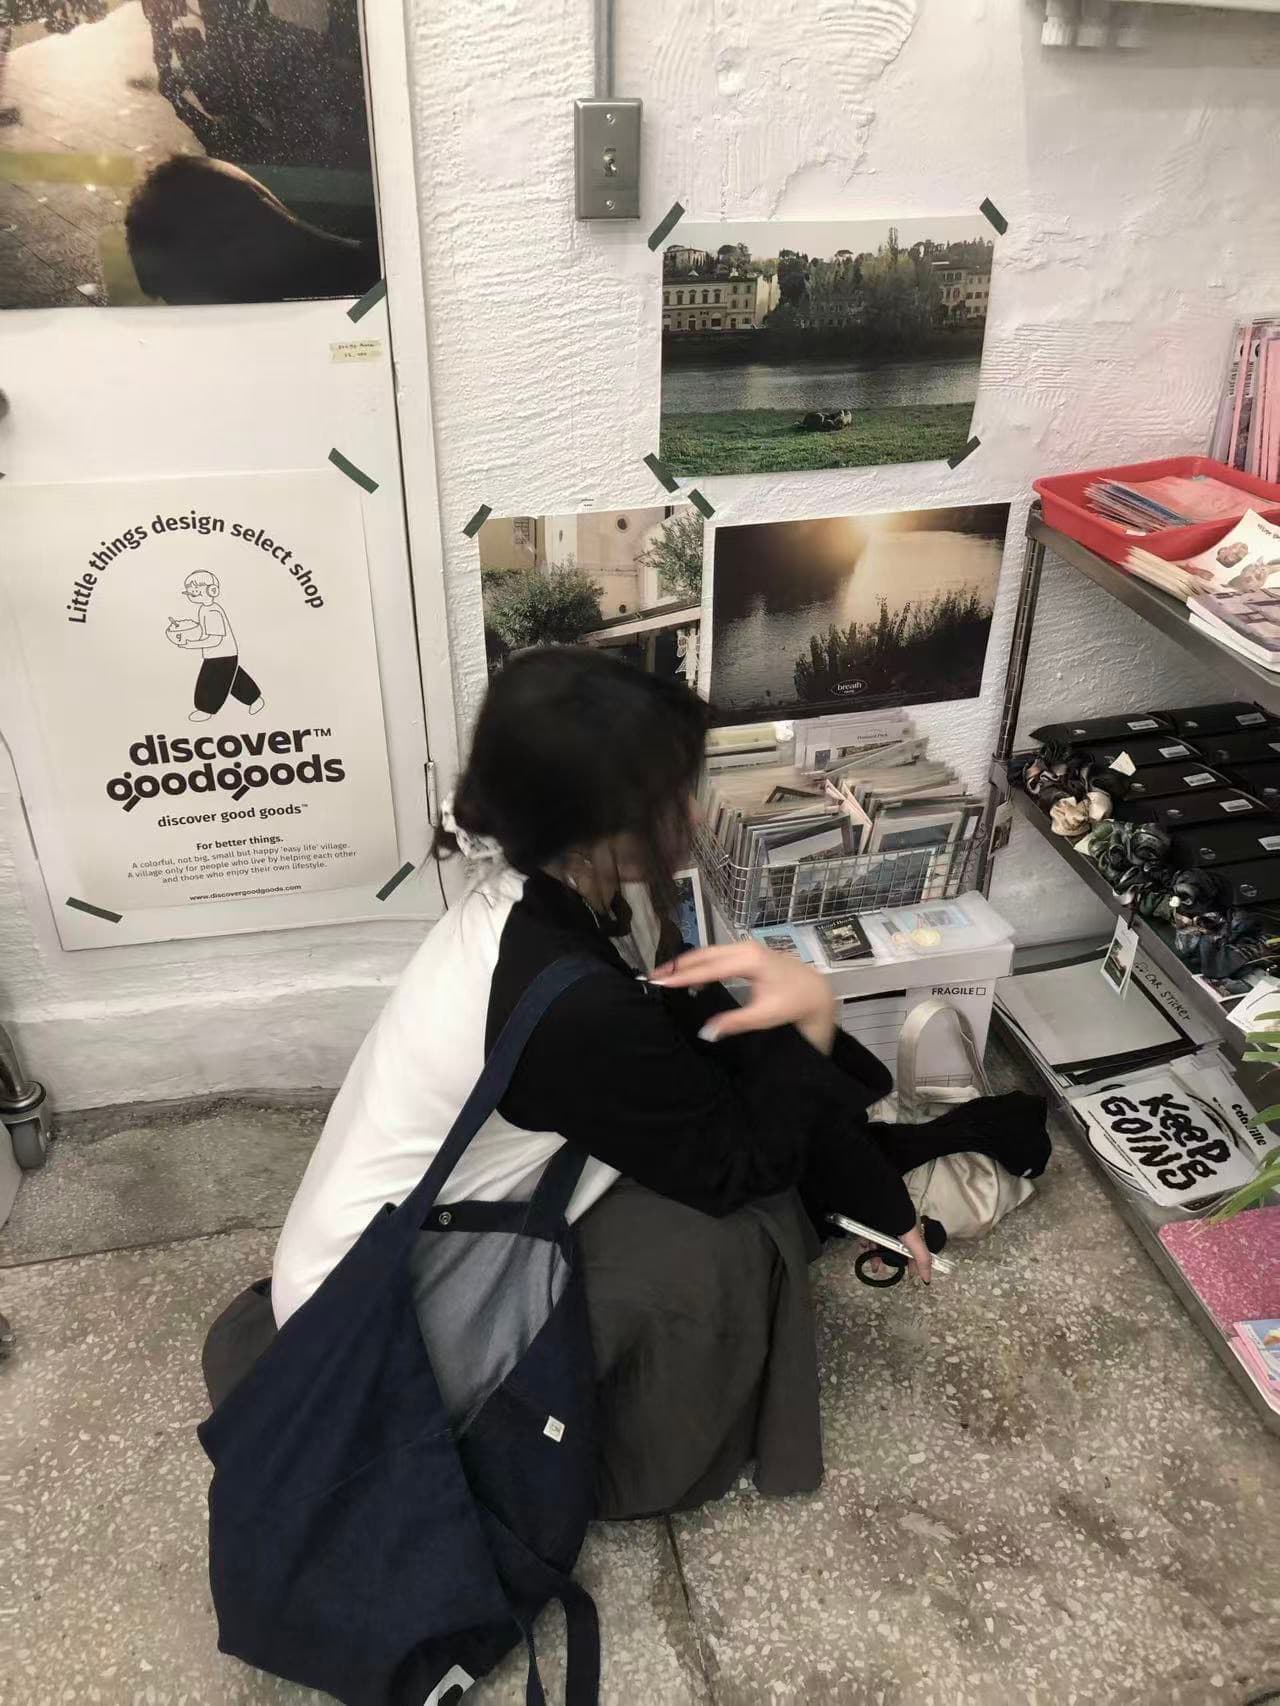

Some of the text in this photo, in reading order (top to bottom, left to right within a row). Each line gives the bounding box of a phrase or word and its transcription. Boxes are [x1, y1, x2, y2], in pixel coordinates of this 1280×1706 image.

[67, 510, 324, 623] Little things design select shop
[157, 812, 217, 827] discover
[220, 807, 256, 823] good
[196, 835, 284, 850] For better things.
[135, 869, 163, 877] village
[165, 865, 184, 875] only
[186, 863, 198, 872] for
[200, 860, 229, 871] people
[231, 858, 249, 866] who
[251, 857, 266, 865] live
[268, 855, 278, 863] by
[280, 852, 311, 862] helping
[313, 850, 333, 860] each
[334, 849, 357, 859] other
[211, 851, 234, 860] small
[237, 849, 251, 857] but
[253, 846, 279, 856] happy
[162, 876, 179, 884] and
[180, 872, 205, 882] those
[207, 870, 224, 879] who
[226, 868, 249, 877] enjoy
[250, 865, 271, 874] their
[273, 863, 290, 871] own
[931, 986, 975, 996] FRAGILE
